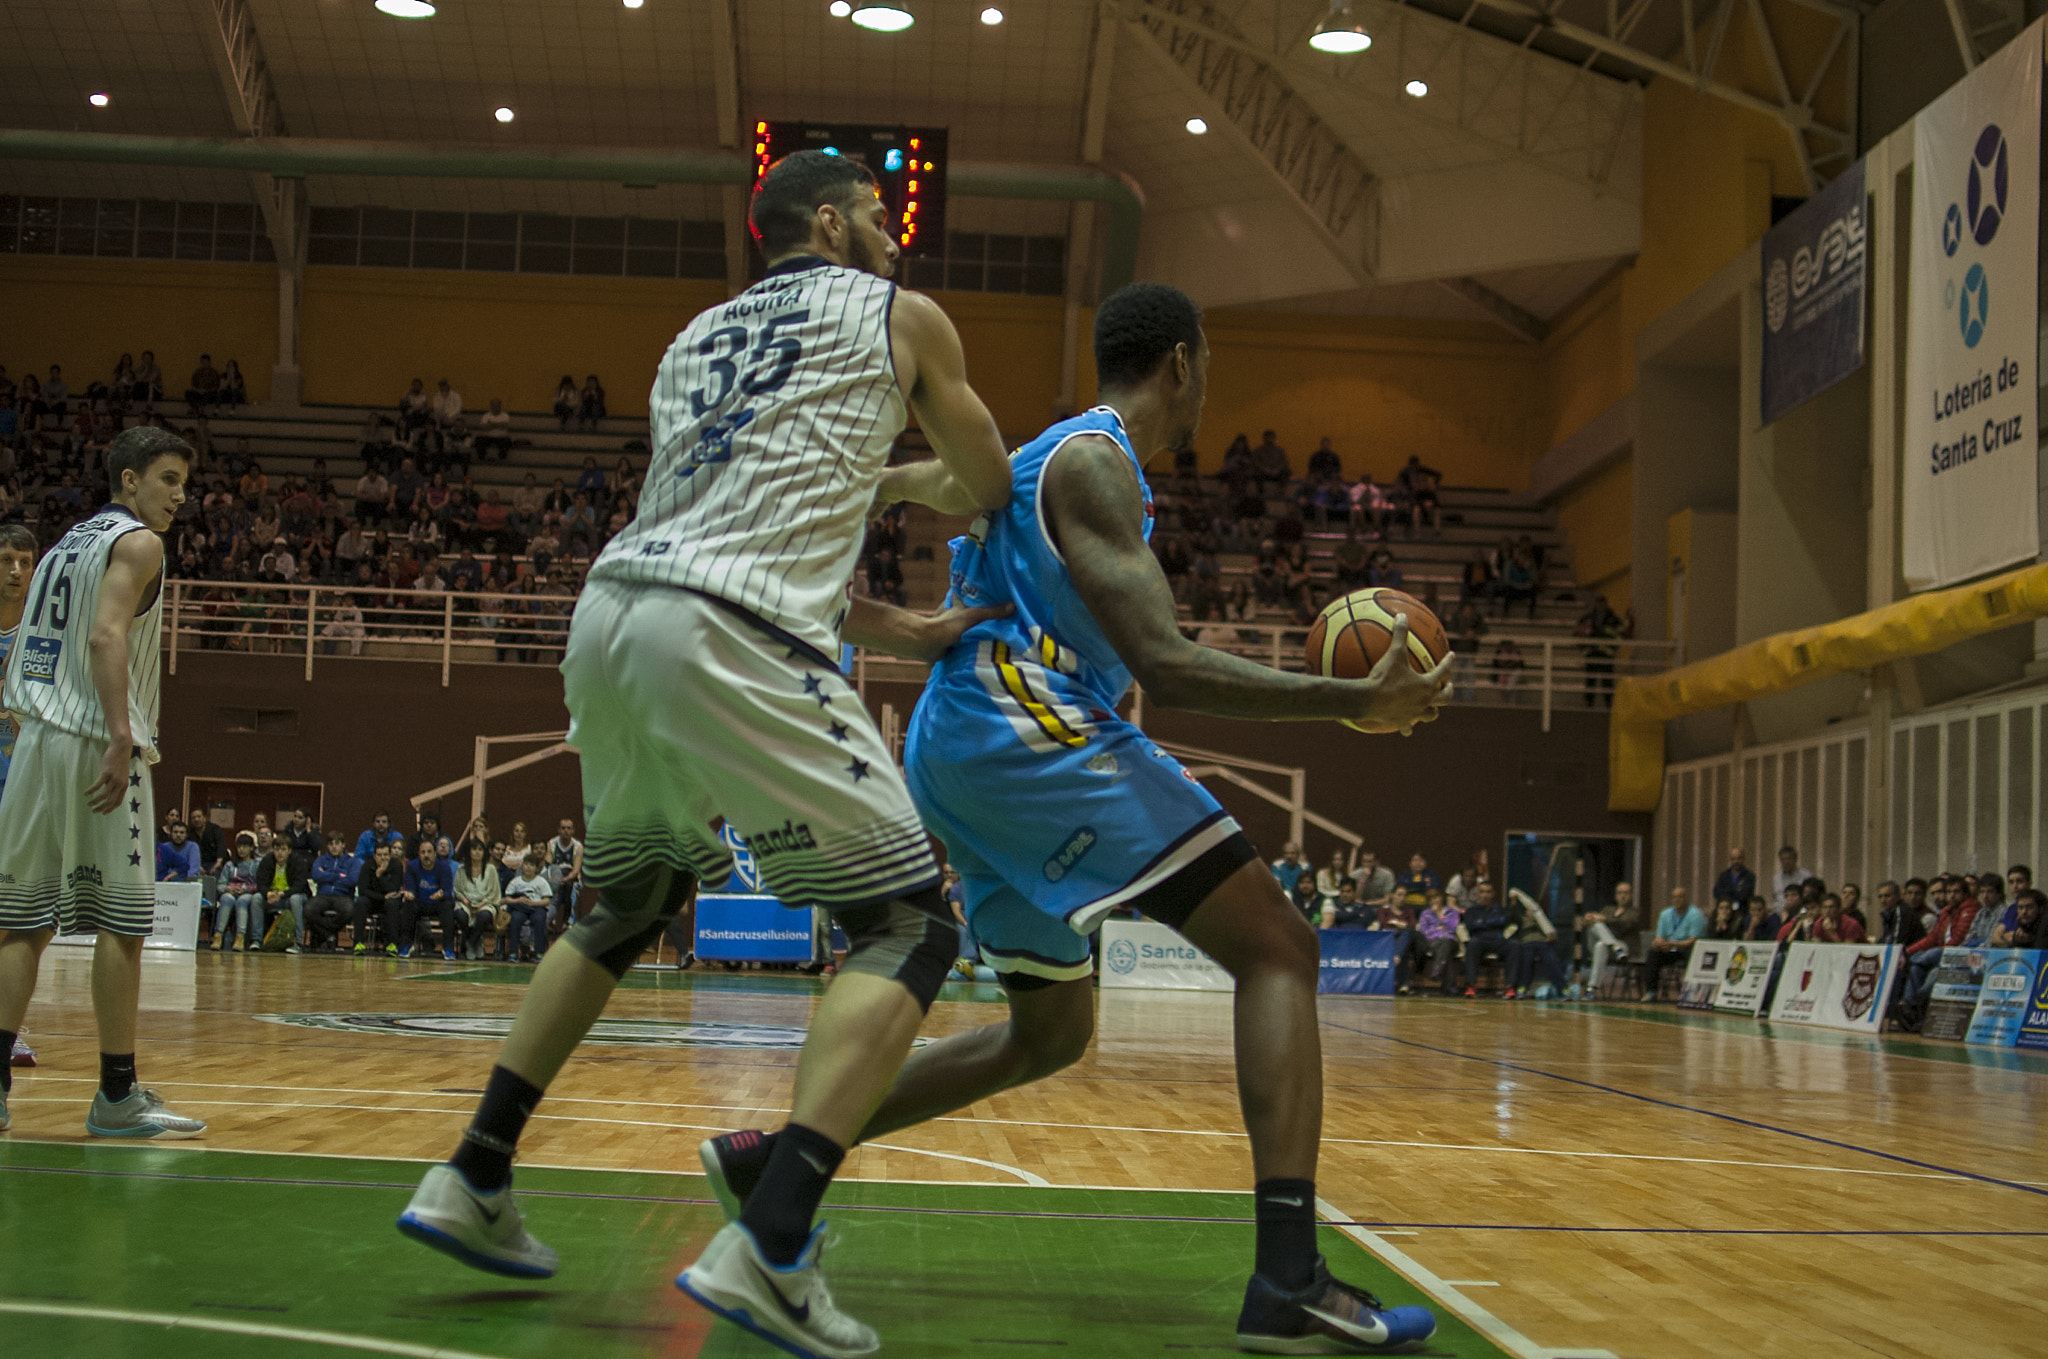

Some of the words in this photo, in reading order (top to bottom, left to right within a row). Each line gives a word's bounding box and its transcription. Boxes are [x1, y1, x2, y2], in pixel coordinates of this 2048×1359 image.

[689, 308, 810, 418] 35
[1932, 369, 1993, 422] Lotería
[1997, 356, 2019, 392] de
[1931, 433, 1977, 476] Santa
[1983, 413, 2022, 454] Cruz
[29, 552, 79, 631] 15
[1141, 944, 1197, 960] Santa
[1330, 958, 1361, 969] Santa
[1363, 958, 1390, 969] Cruz
[2028, 1011, 2048, 1026] ALA
